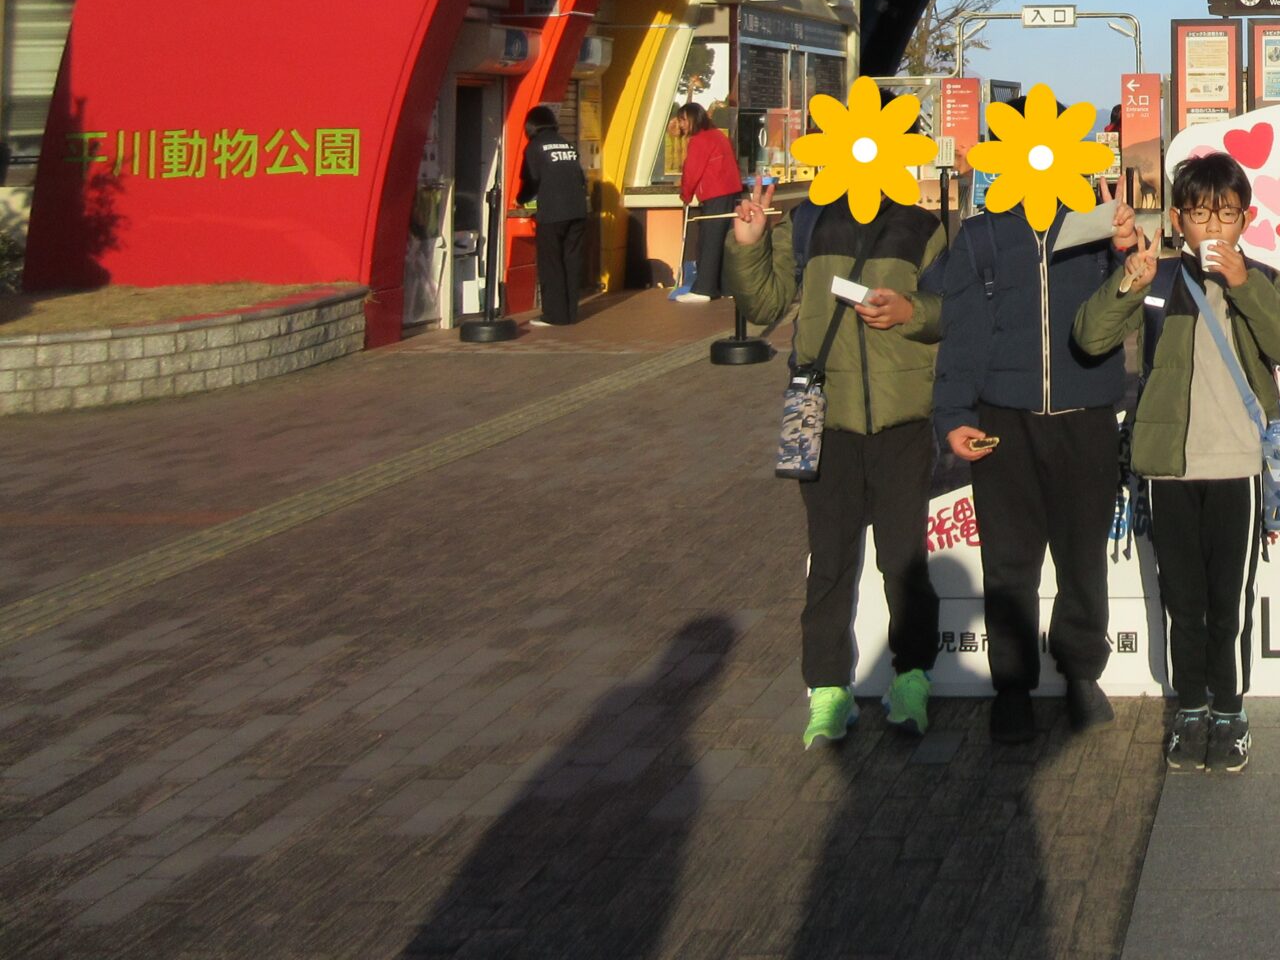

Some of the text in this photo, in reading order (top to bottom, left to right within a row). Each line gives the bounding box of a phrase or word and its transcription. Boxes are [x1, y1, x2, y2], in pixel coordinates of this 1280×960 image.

[1031, 9, 1066, 23] 入口
[1126, 95, 1150, 106] 入口
[63, 128, 361, 179] 平川動物公園
[551, 151, 578, 162] STAFF
